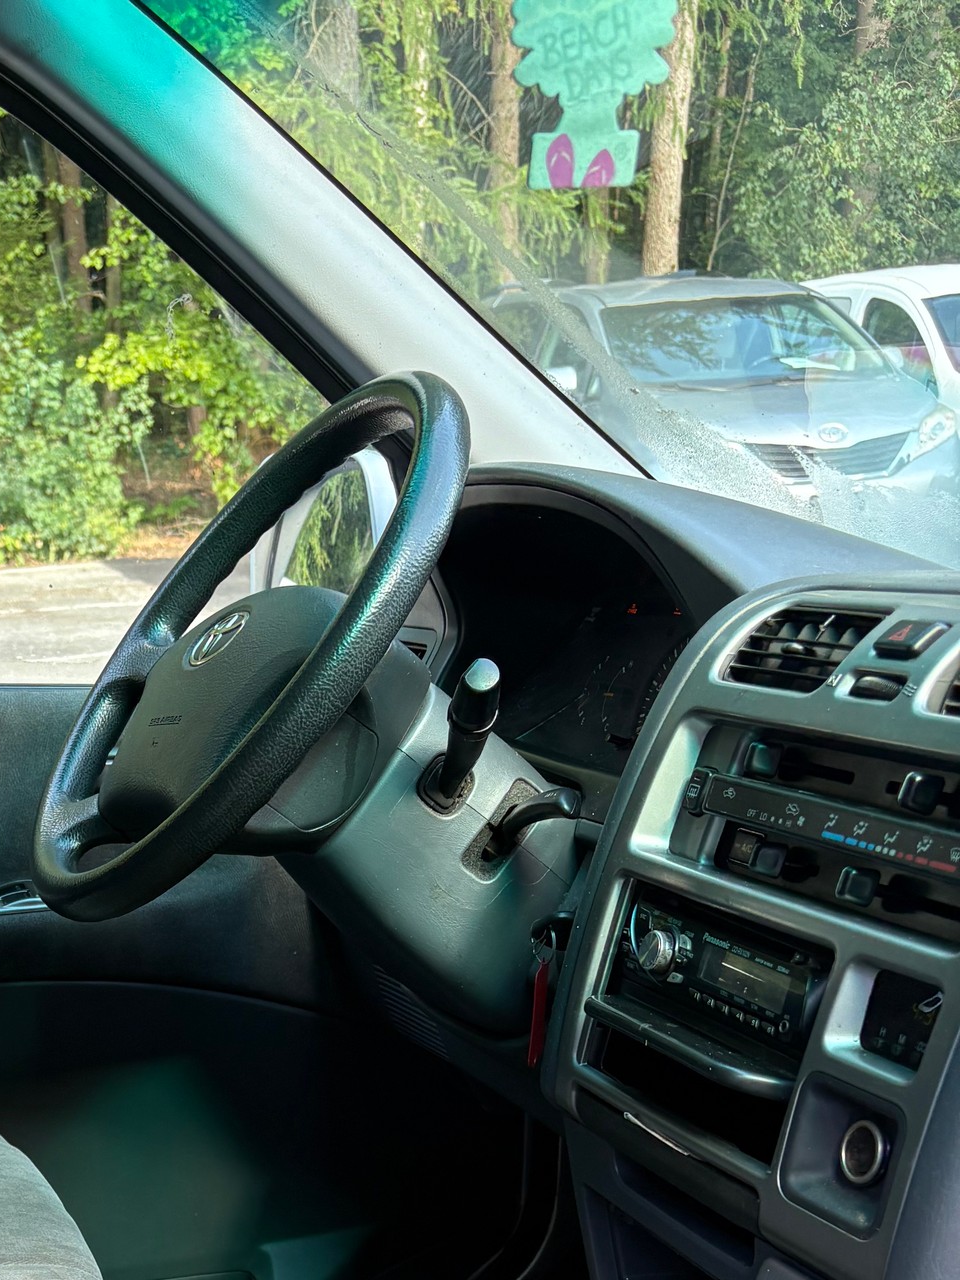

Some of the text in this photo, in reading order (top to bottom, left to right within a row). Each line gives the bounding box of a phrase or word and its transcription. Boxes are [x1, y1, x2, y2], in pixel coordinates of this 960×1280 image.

[539, 5, 631, 70] BEACH
[564, 46, 633, 99] DAYS
[747, 809, 757, 817] OFF
[759, 812, 768, 821] LO
[741, 843, 753, 853] A/C
[703, 932, 731, 949] Panasonic
[879, 1027, 887, 1036] H
[898, 1034, 907, 1044] M
